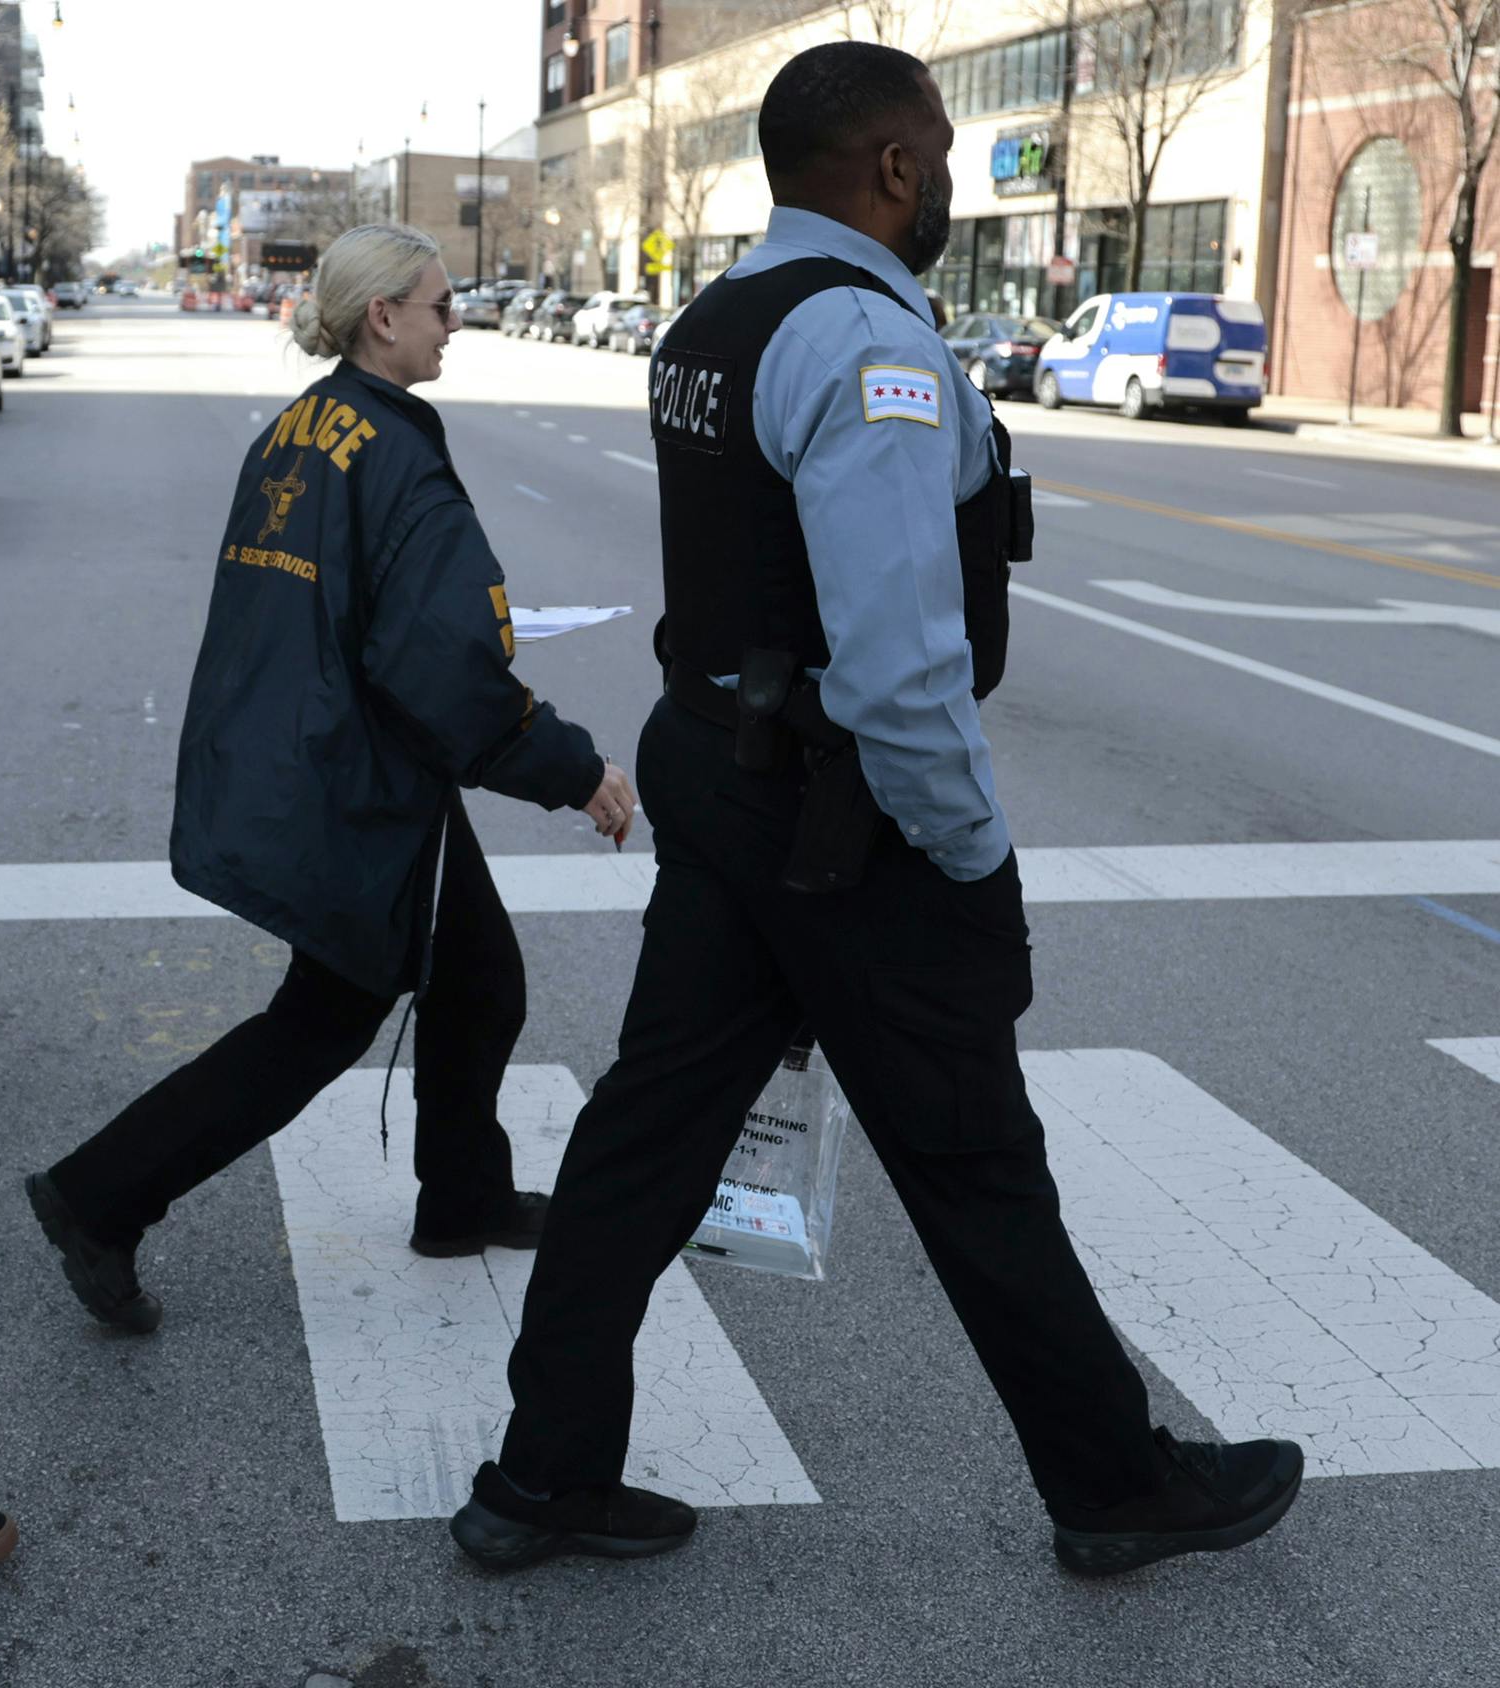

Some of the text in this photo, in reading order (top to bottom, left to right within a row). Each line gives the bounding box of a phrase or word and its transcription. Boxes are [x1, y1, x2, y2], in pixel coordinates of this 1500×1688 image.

[651, 360, 723, 439] POLICE
[261, 394, 378, 473] POLICE
[746, 1111, 809, 1134] METHING
[742, 1128, 784, 1145] THING
[731, 1145, 757, 1158] -1-1
[712, 1194, 734, 1212] MC
